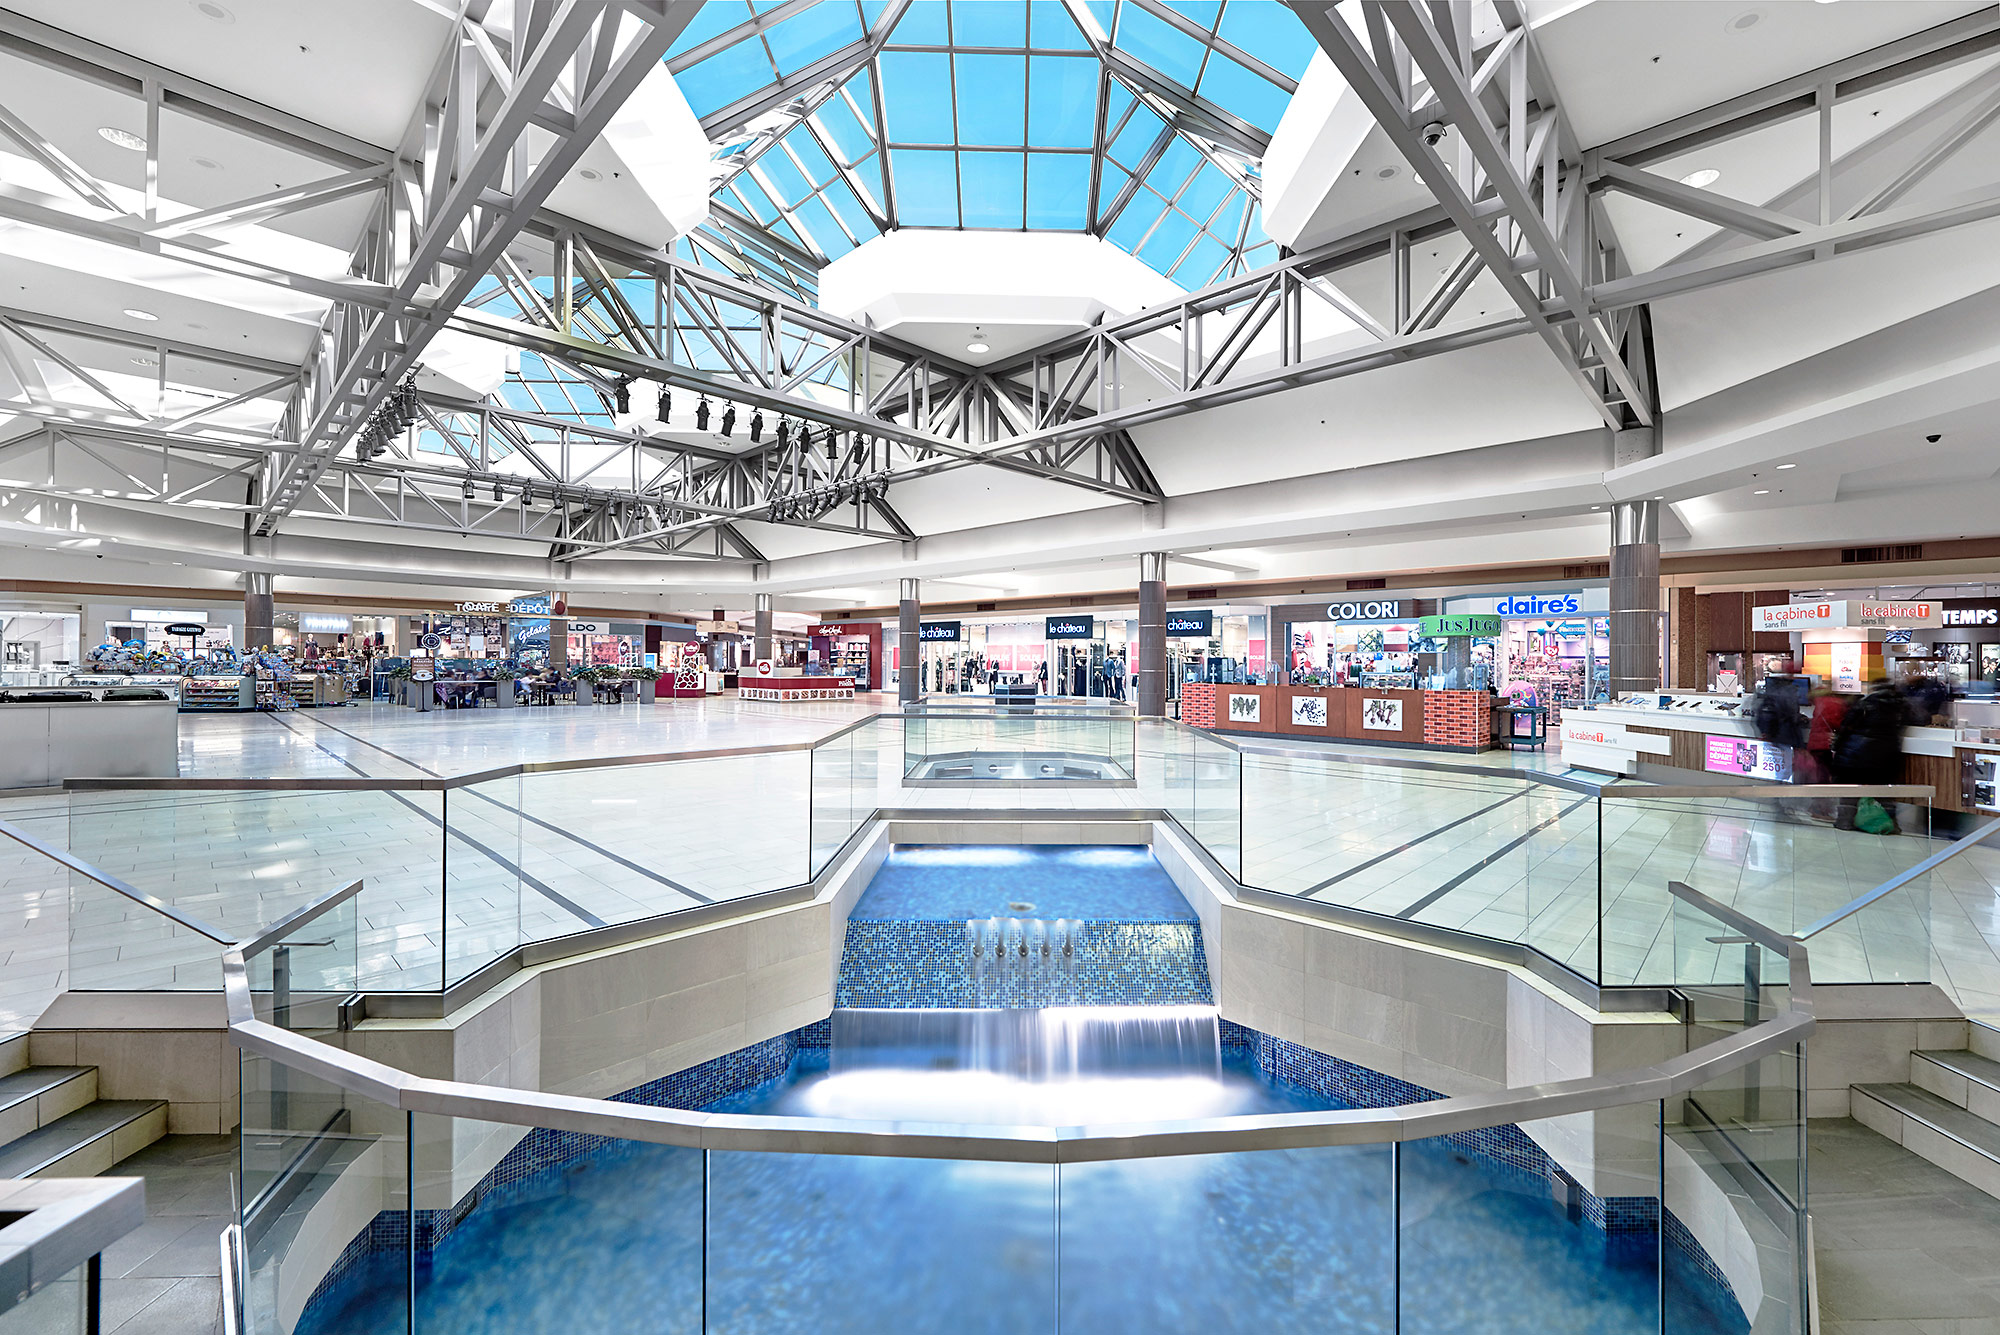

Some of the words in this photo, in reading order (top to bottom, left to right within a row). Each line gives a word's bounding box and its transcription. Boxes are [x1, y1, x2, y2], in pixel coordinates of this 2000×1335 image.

[510, 602, 550, 614] DÉPÔT
[1327, 601, 1398, 620] COLORI
[1497, 594, 1579, 616] claire's
[1861, 603, 1872, 617] la
[1873, 603, 1916, 617] cabine
[1763, 609, 1773, 621] la
[1775, 607, 1816, 620] cabine
[1941, 609, 1998, 625] TEMPS
[1167, 618, 1203, 631] château
[1437, 618, 1463, 633] JUS
[1877, 617, 1886, 625] fil
[568, 624, 596, 632] LDO
[927, 626, 954, 638] château
[1049, 622, 1057, 634] le
[1057, 622, 1086, 634] château
[1569, 729, 1575, 739] la
[1575, 731, 1596, 742] cabine
[1709, 752, 1733, 761] DÉPART
